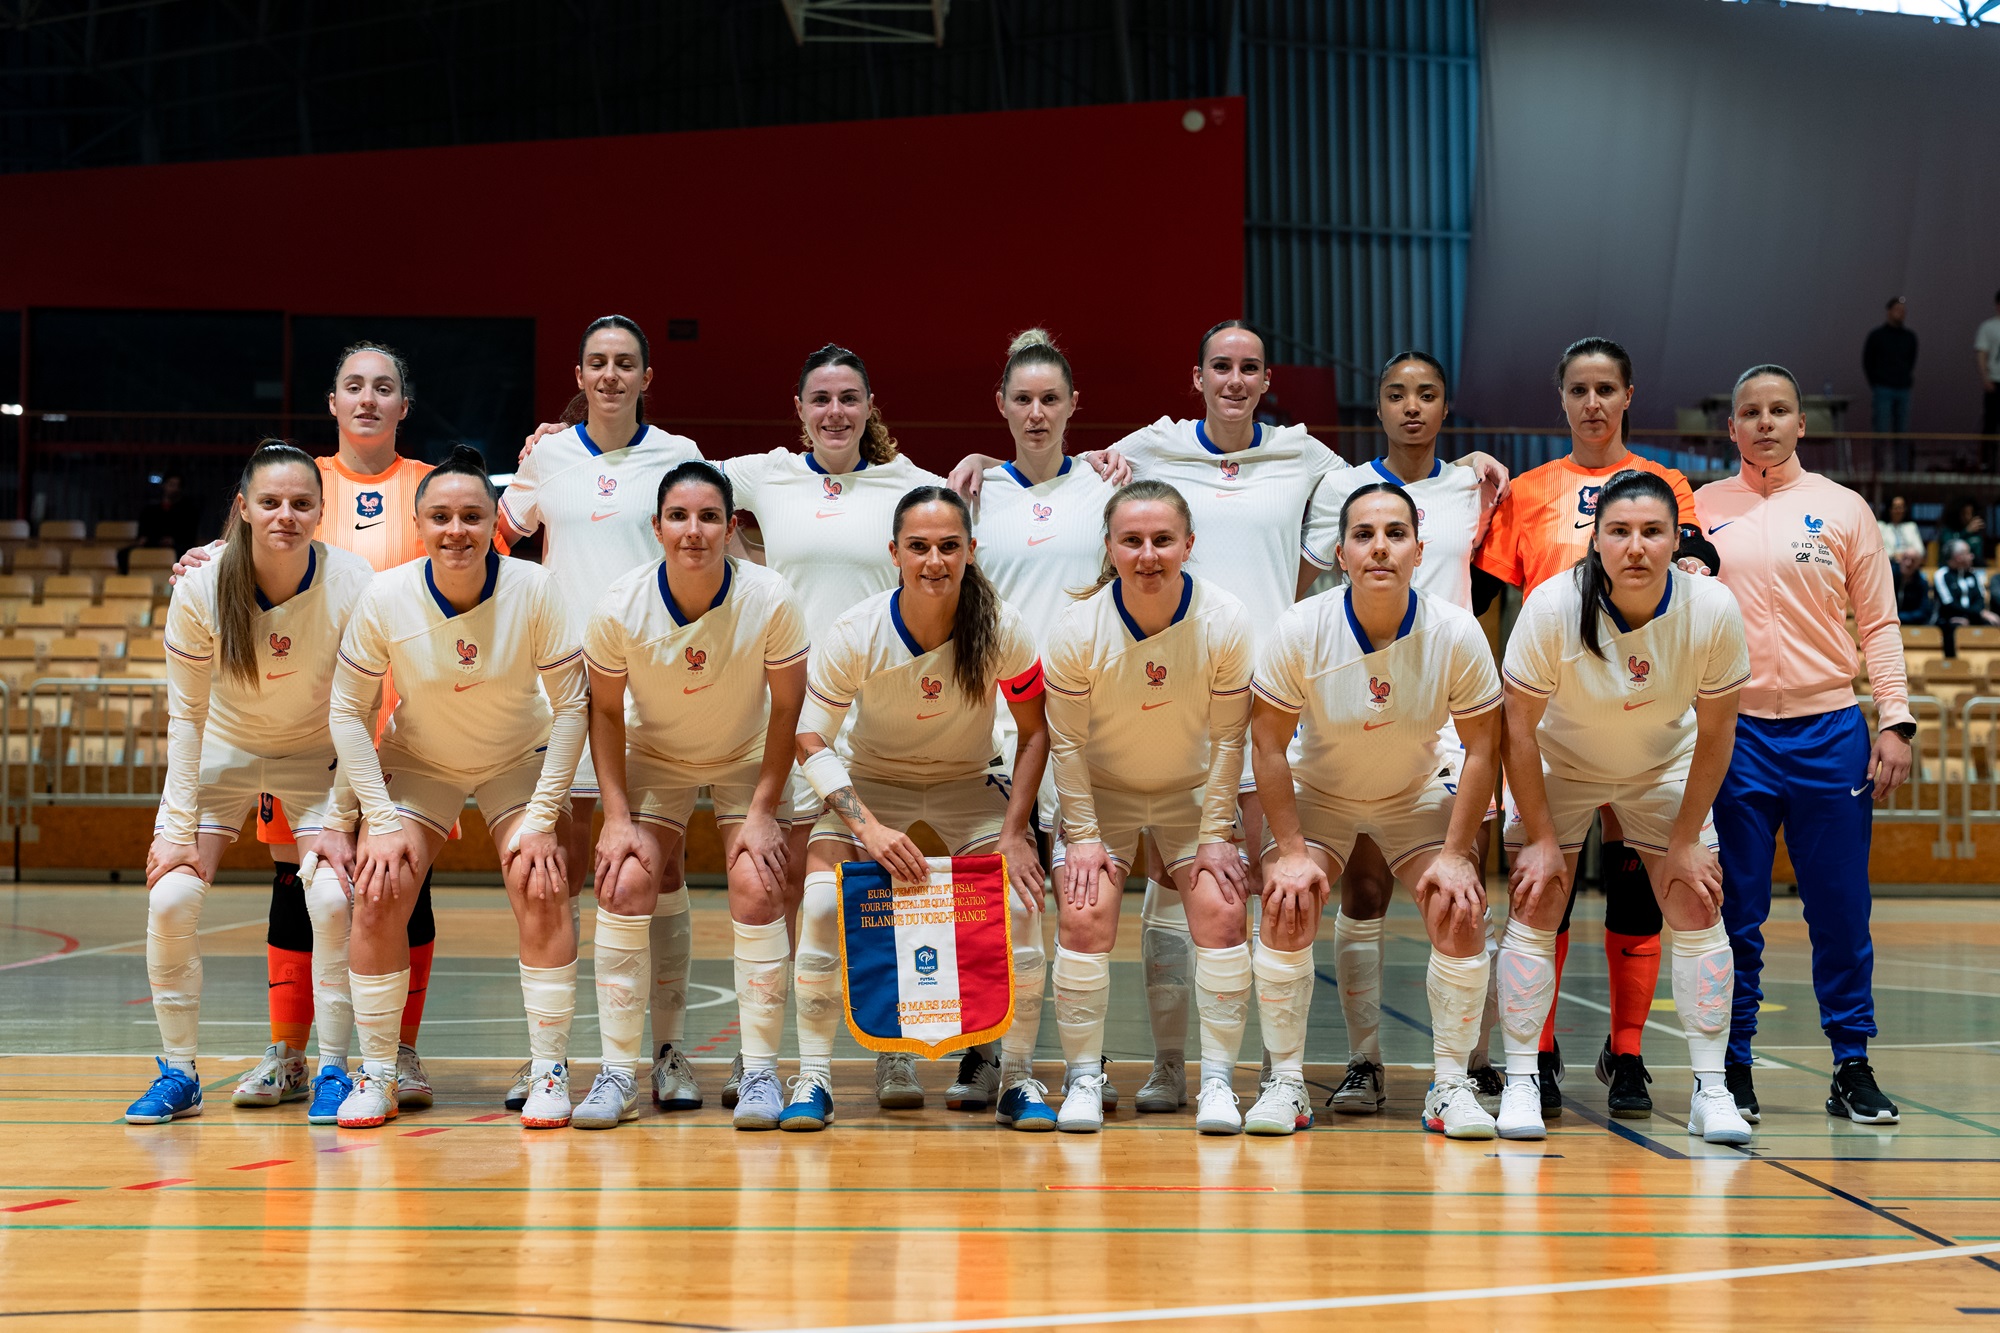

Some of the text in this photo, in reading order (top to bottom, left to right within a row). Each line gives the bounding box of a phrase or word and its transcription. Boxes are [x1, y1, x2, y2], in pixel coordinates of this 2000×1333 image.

[867, 888, 892, 899] EURO
[929, 885, 943, 895] DE
[943, 883, 977, 895] FUTSAL
[860, 895, 986, 913] TOUR PRINCIPAL DE QUALIFICATION
[861, 909, 988, 928] IRLANDE DU NORD-FRANCE
[907, 999, 940, 1012] MARS
